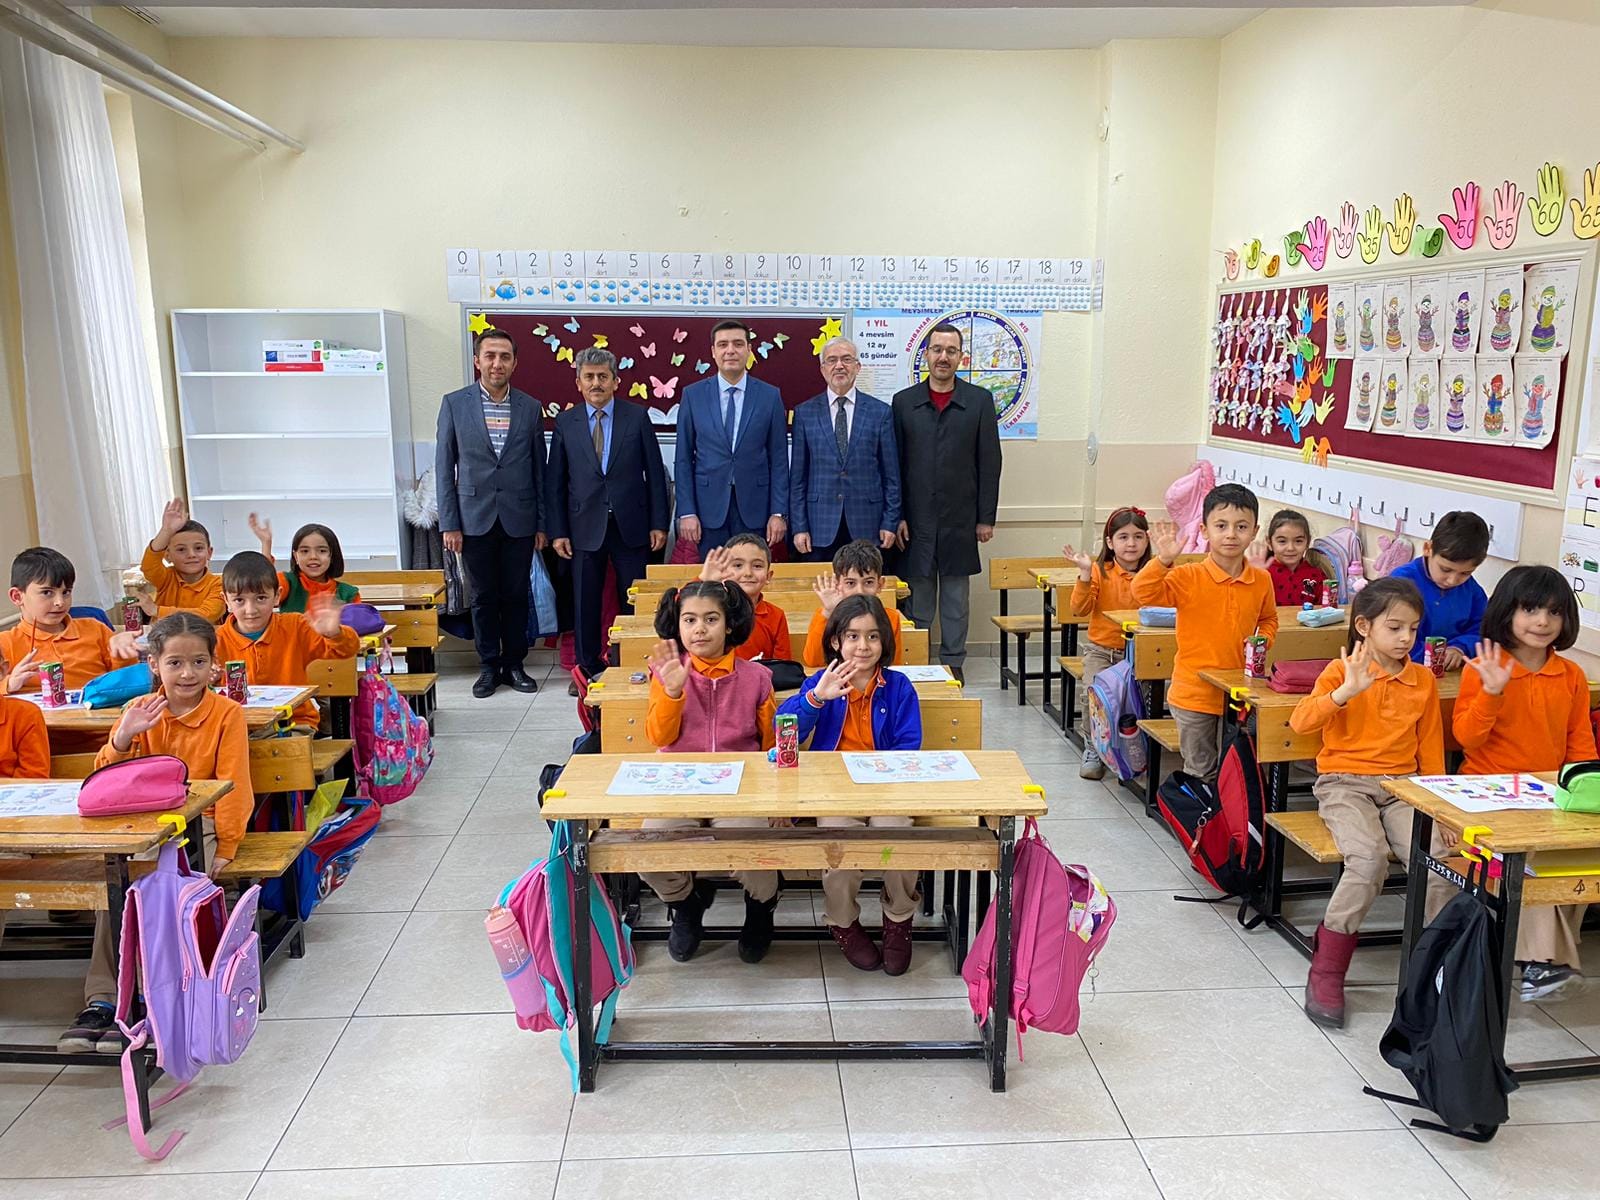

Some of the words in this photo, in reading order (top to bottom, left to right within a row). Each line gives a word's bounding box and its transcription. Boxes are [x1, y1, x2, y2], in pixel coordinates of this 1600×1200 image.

[1539, 201, 1559, 224] 60
[1581, 205, 1600, 228] 65
[1395, 226, 1409, 246] 40
[1457, 219, 1473, 239] 50
[1495, 217, 1514, 240] 55
[1338, 232, 1352, 250] 30
[1365, 237, 1378, 256] 35
[457, 251, 467, 265] 0
[496, 253, 502, 267] 1
[528, 252, 537, 267] 2
[564, 253, 573, 267] 3
[596, 253, 606, 267] 4
[629, 254, 638, 268] 5
[661, 254, 670, 268] 6
[694, 255, 702, 269] 7
[725, 255, 733, 269] 8
[757, 255, 765, 269] 9
[786, 256, 802, 270] 10
[820, 257, 832, 271] 11
[851, 257, 865, 272] 12
[881, 257, 896, 272] 13
[912, 258, 928, 272] 14
[943, 258, 958, 273] 15
[975, 259, 989, 274] 16
[1007, 260, 1021, 274] 17
[1038, 260, 1052, 275] 18
[1069, 260, 1083, 275] 19
[1312, 246, 1324, 263] 25
[905, 317, 932, 353] SONBAHAR
[871, 352, 898, 360] gündür
[1583, 496, 1599, 528] E
[1574, 577, 1586, 608] R
